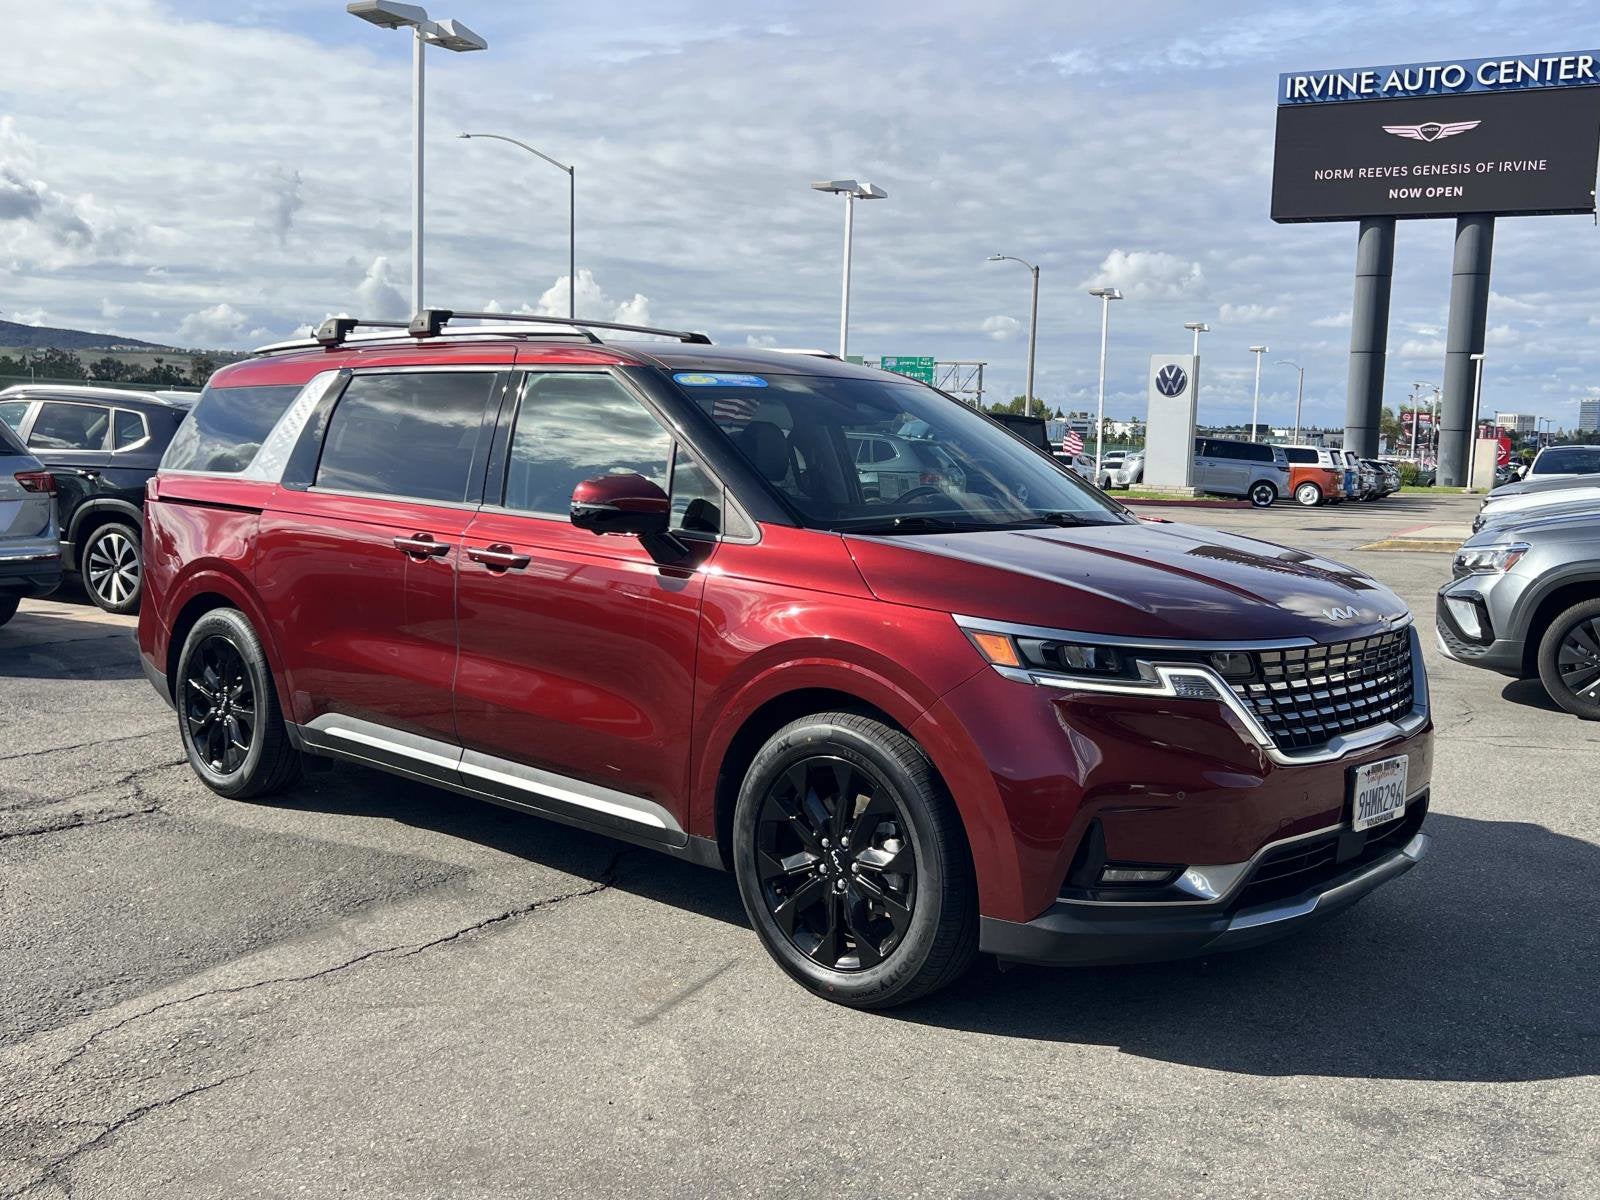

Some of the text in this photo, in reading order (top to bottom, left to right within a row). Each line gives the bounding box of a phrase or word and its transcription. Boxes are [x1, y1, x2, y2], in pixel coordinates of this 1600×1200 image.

[1286, 55, 1594, 98] IRVINE AUTO CENTER
[1315, 159, 1547, 180] NORM REEVES GENESIS OF IRVINE
[1389, 186, 1463, 199] NOW OPEN
[1156, 364, 1187, 397] VW
[1358, 779, 1404, 821] 9HMR296
